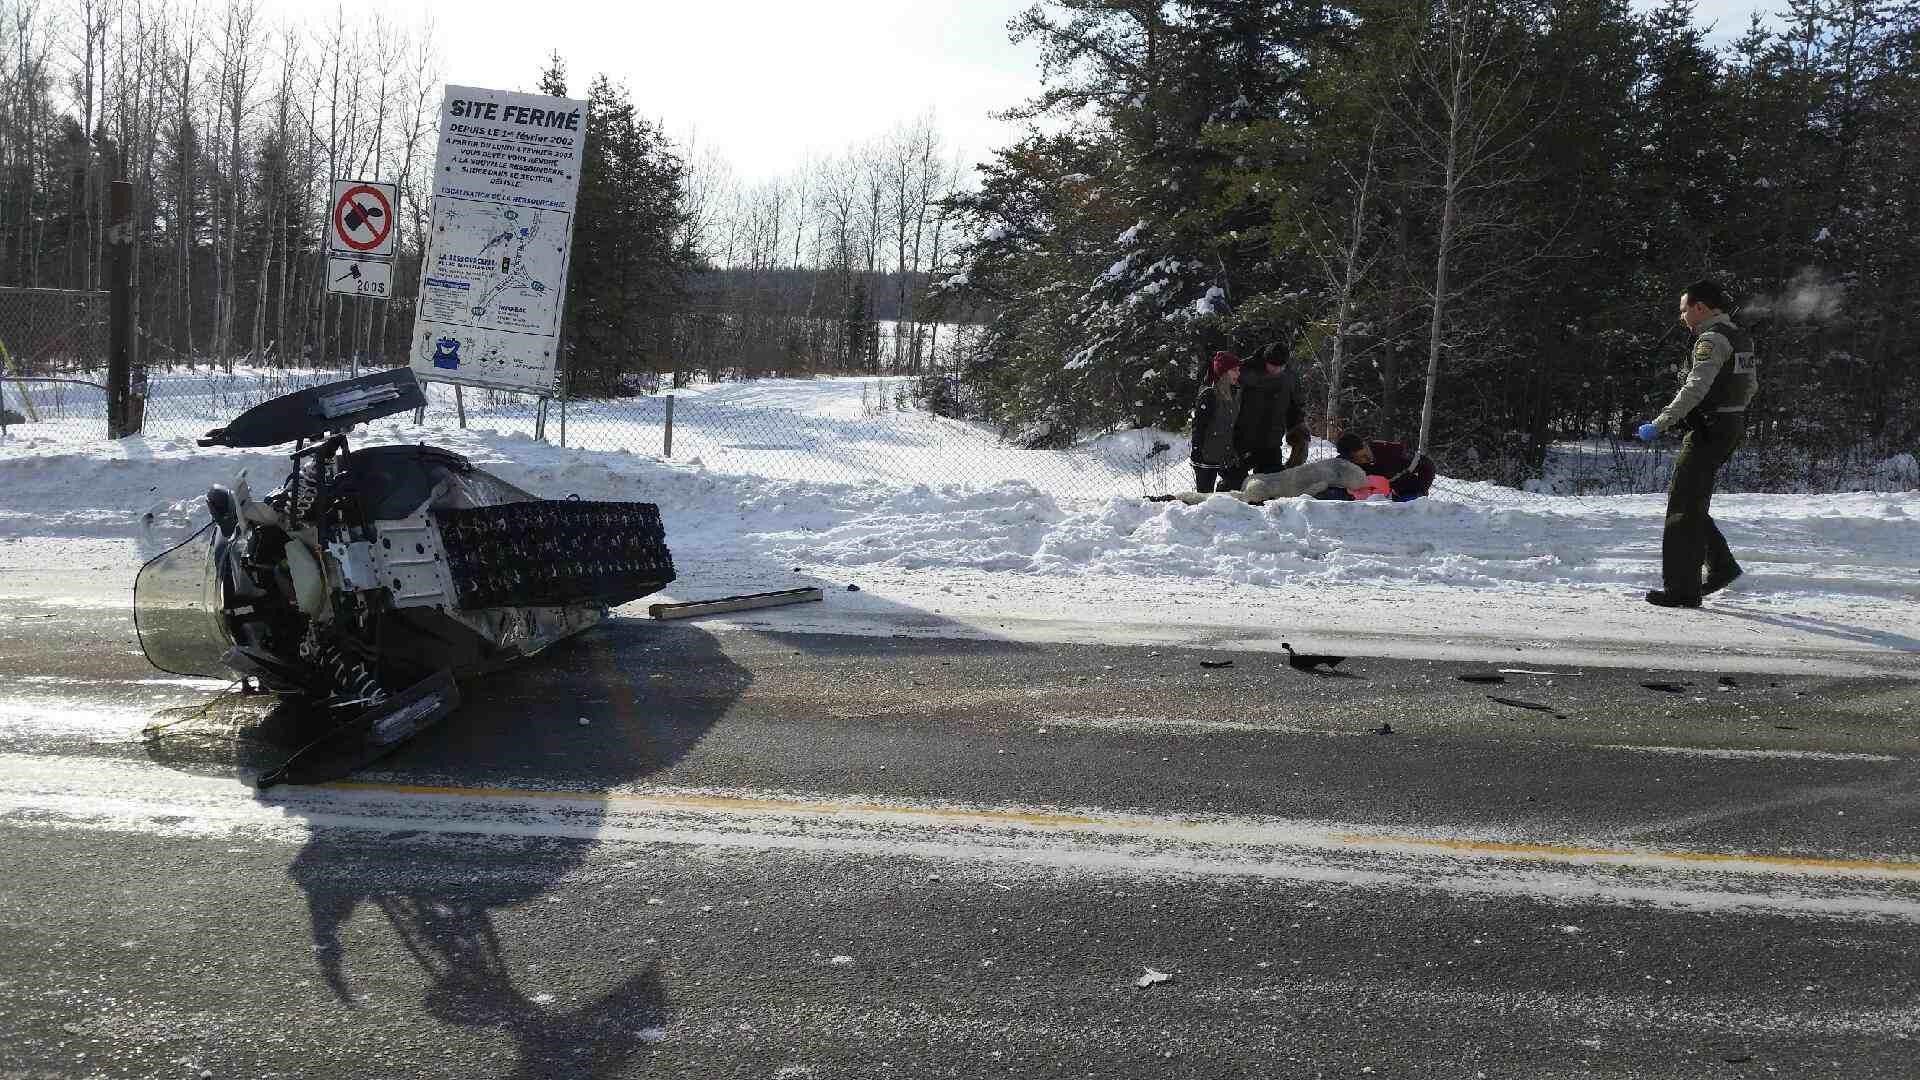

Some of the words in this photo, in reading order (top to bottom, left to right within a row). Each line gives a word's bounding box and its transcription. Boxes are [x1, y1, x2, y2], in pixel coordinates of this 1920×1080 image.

[450, 99, 499, 121] SITE
[502, 106, 581, 131] FERMÉ
[450, 123, 485, 137] DEPUIS
[488, 128, 500, 137] LE
